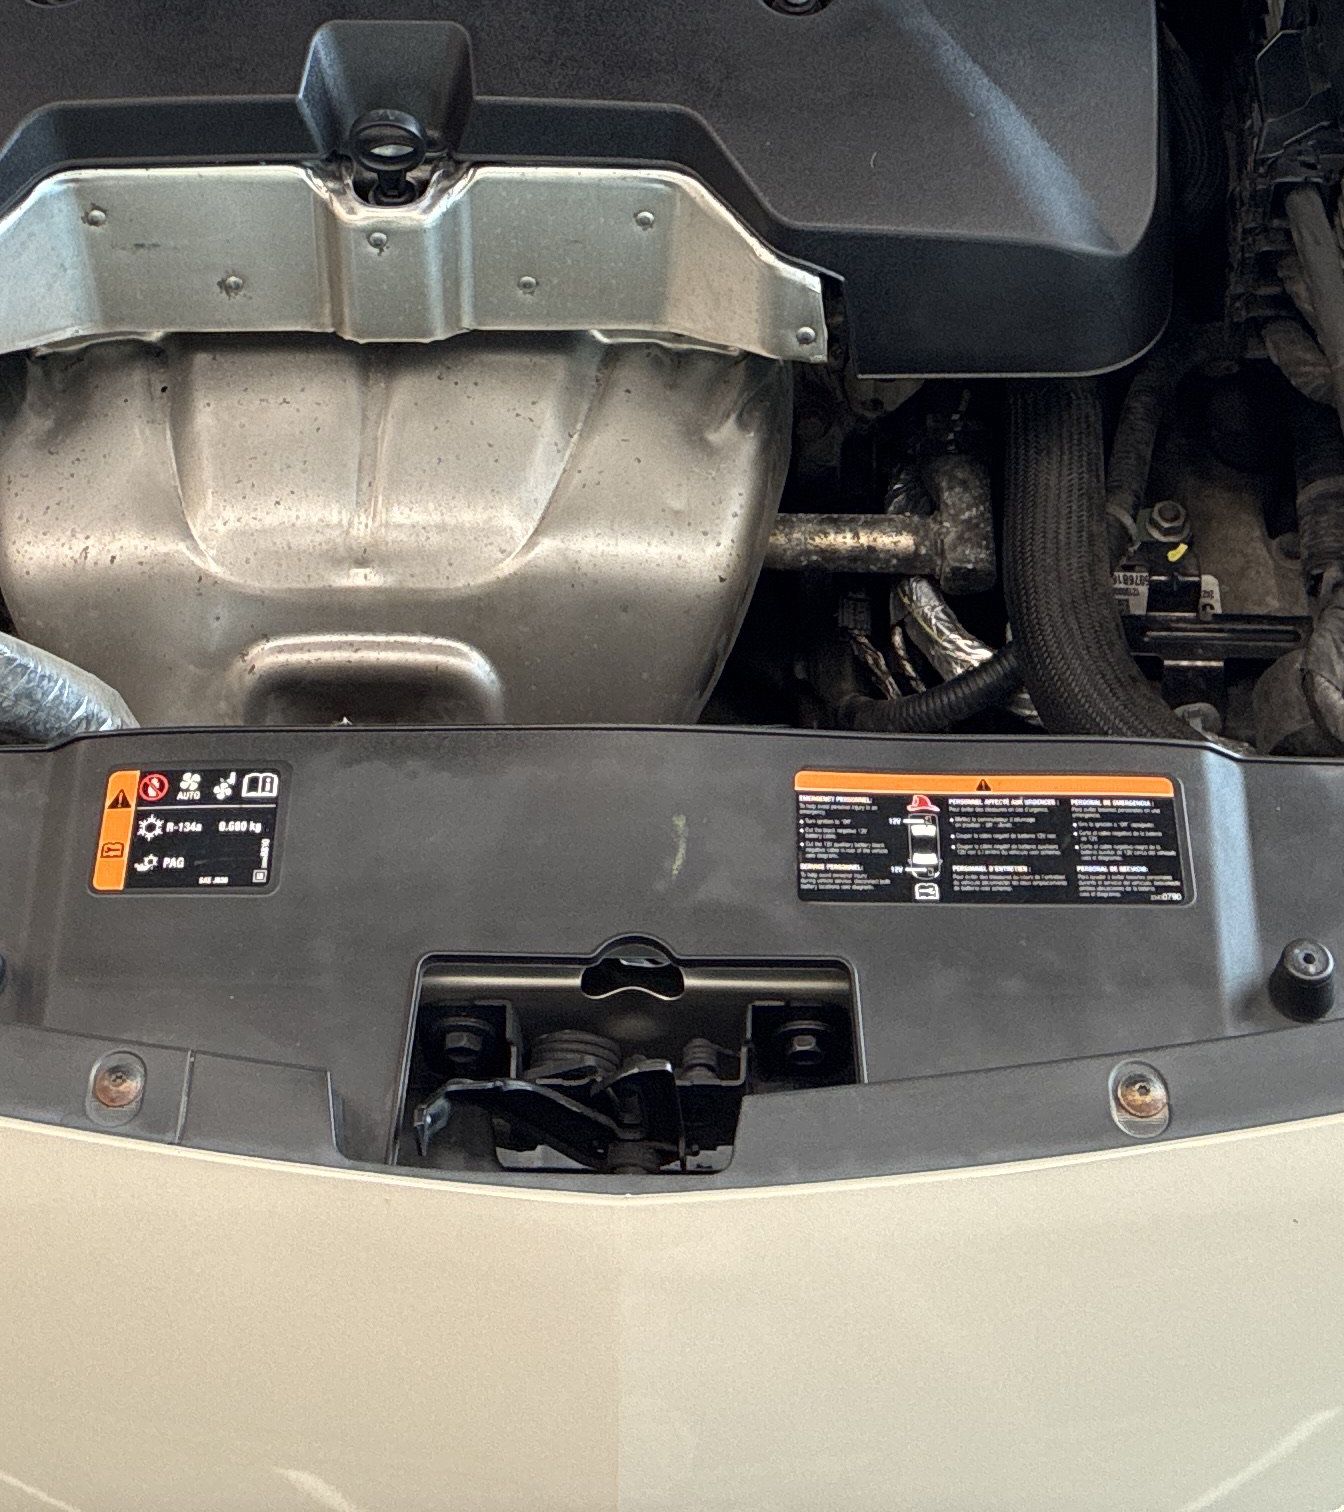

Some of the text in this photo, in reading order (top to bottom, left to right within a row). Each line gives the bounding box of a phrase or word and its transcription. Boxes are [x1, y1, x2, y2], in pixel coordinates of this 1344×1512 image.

[176, 790, 201, 801] AUTO
[165, 822, 203, 833] R-134a
[248, 820, 262, 834] kg
[162, 856, 185, 869] PAG
